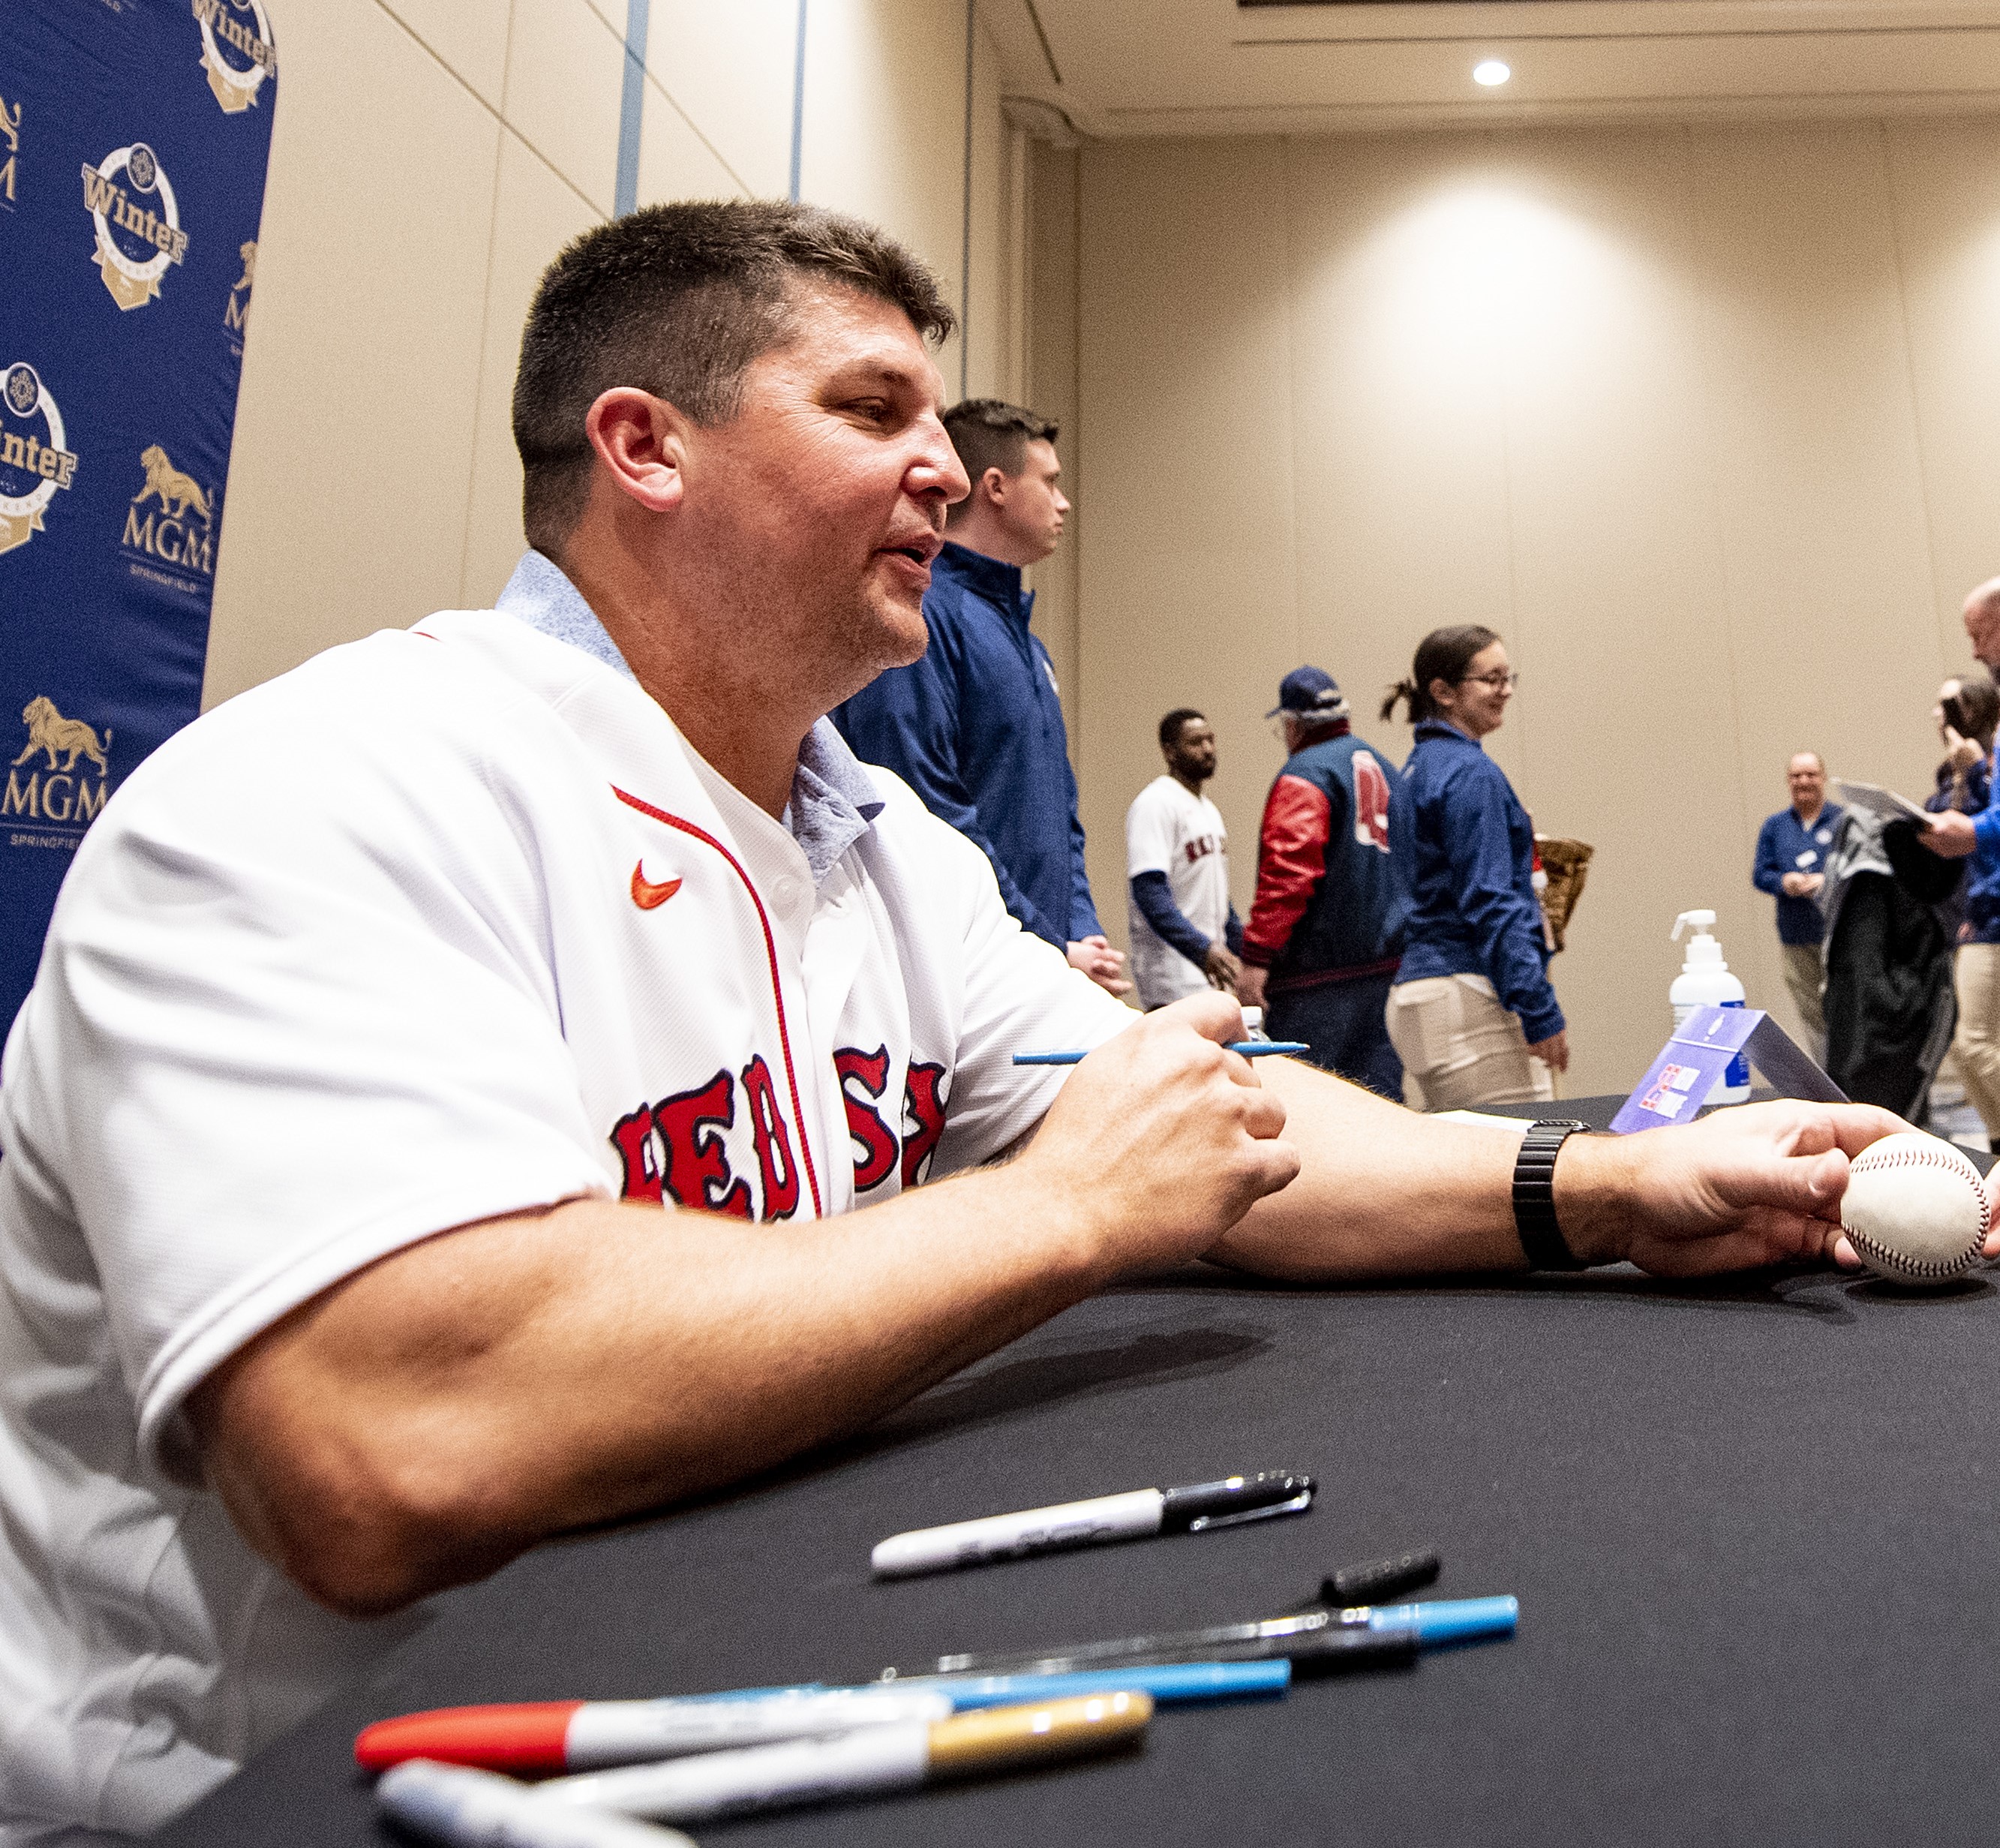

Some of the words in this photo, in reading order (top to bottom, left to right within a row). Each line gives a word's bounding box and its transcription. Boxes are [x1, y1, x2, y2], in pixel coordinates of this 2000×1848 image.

[83, 164, 188, 263] Winter
[0, 429, 76, 486] nter
[122, 505, 211, 574] MGM
[1, 768, 107, 822] MGM
[610, 1053, 800, 1224] RED
